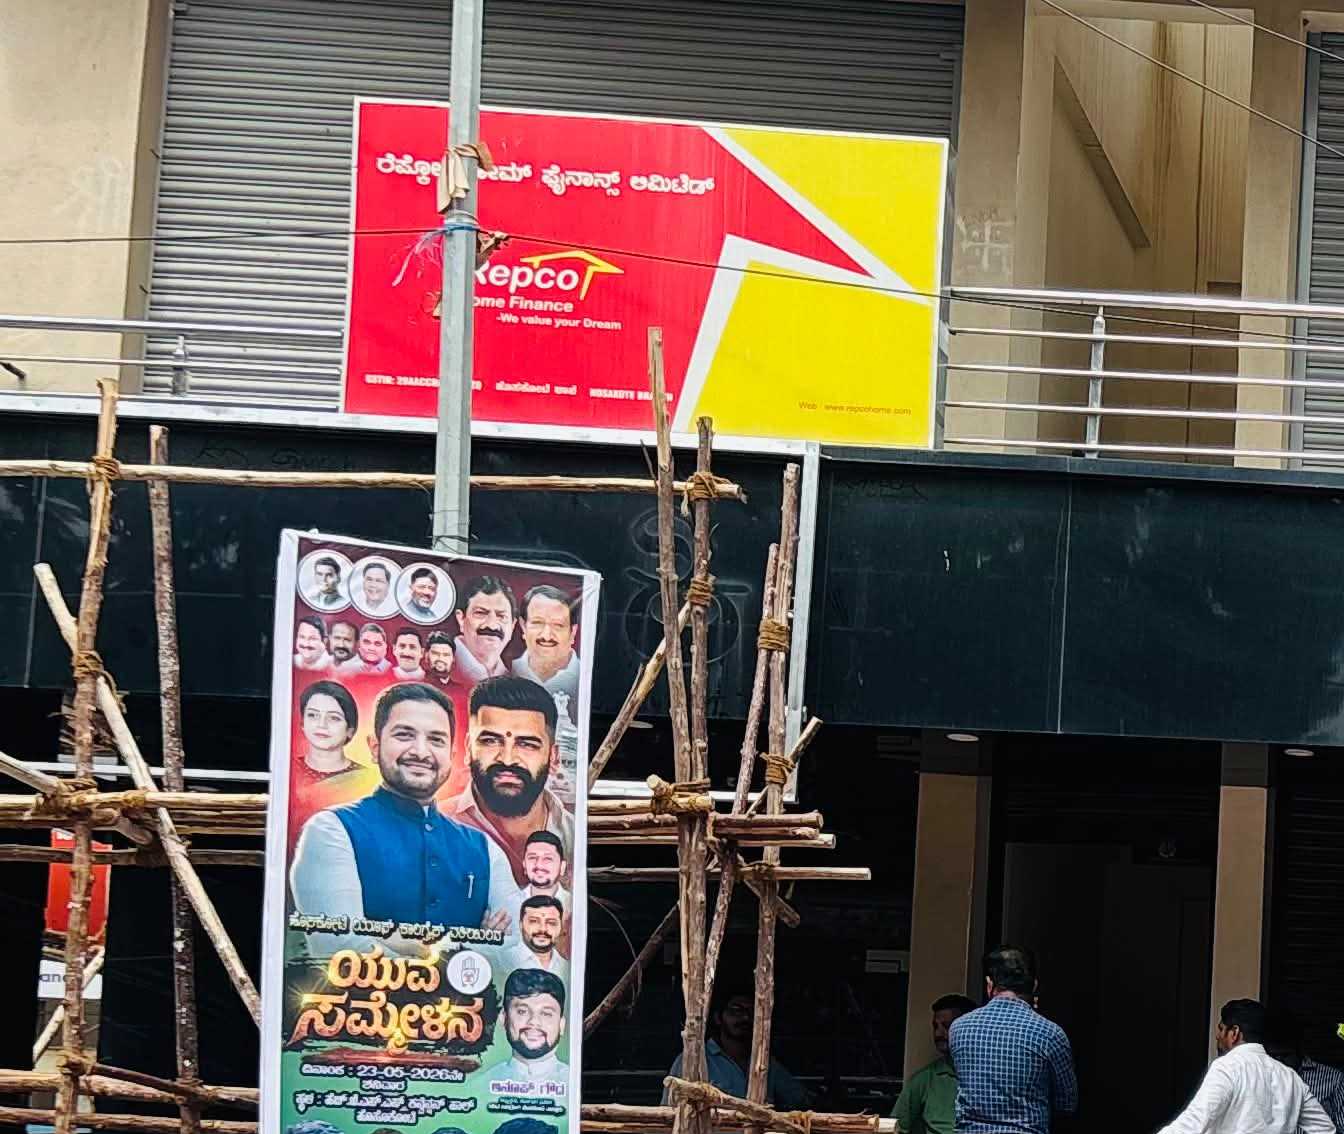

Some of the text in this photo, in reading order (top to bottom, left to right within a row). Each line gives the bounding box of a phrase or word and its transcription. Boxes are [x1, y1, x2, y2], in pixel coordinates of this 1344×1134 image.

[472, 297, 574, 313] ome Finance
[521, 314, 553, 326] value
[554, 316, 581, 329] your
[583, 319, 622, 331] Dream
[328, 945, 441, 993] ಯುವ
